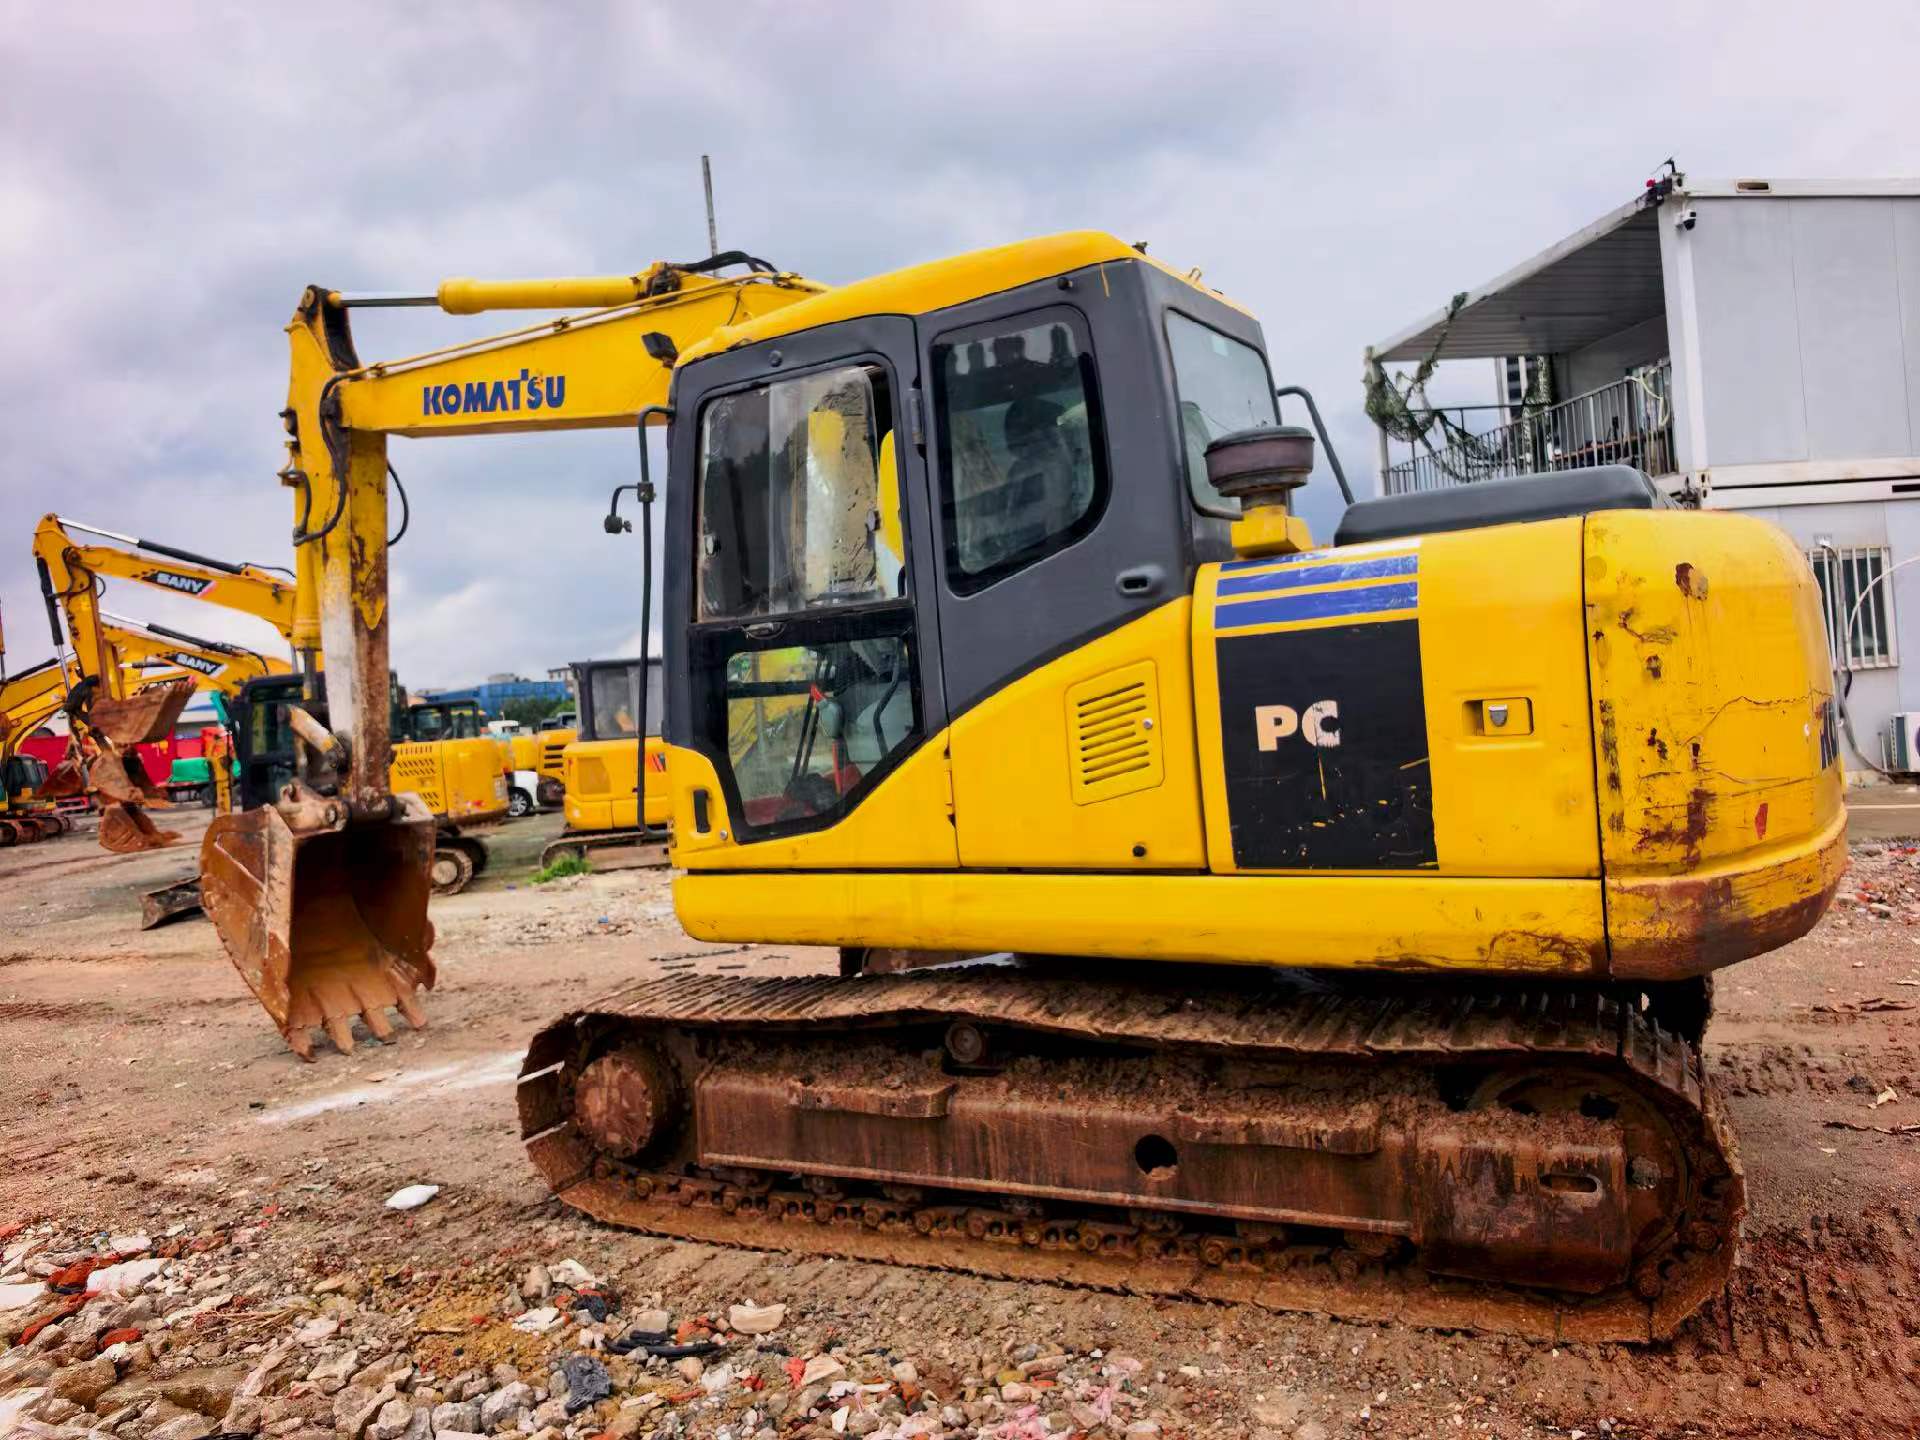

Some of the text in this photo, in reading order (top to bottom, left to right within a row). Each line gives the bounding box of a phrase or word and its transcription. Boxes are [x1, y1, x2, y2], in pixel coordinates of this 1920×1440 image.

[423, 369, 565, 415] KOMATSU
[157, 573, 203, 592] SANY
[1255, 700, 1341, 751] PC
